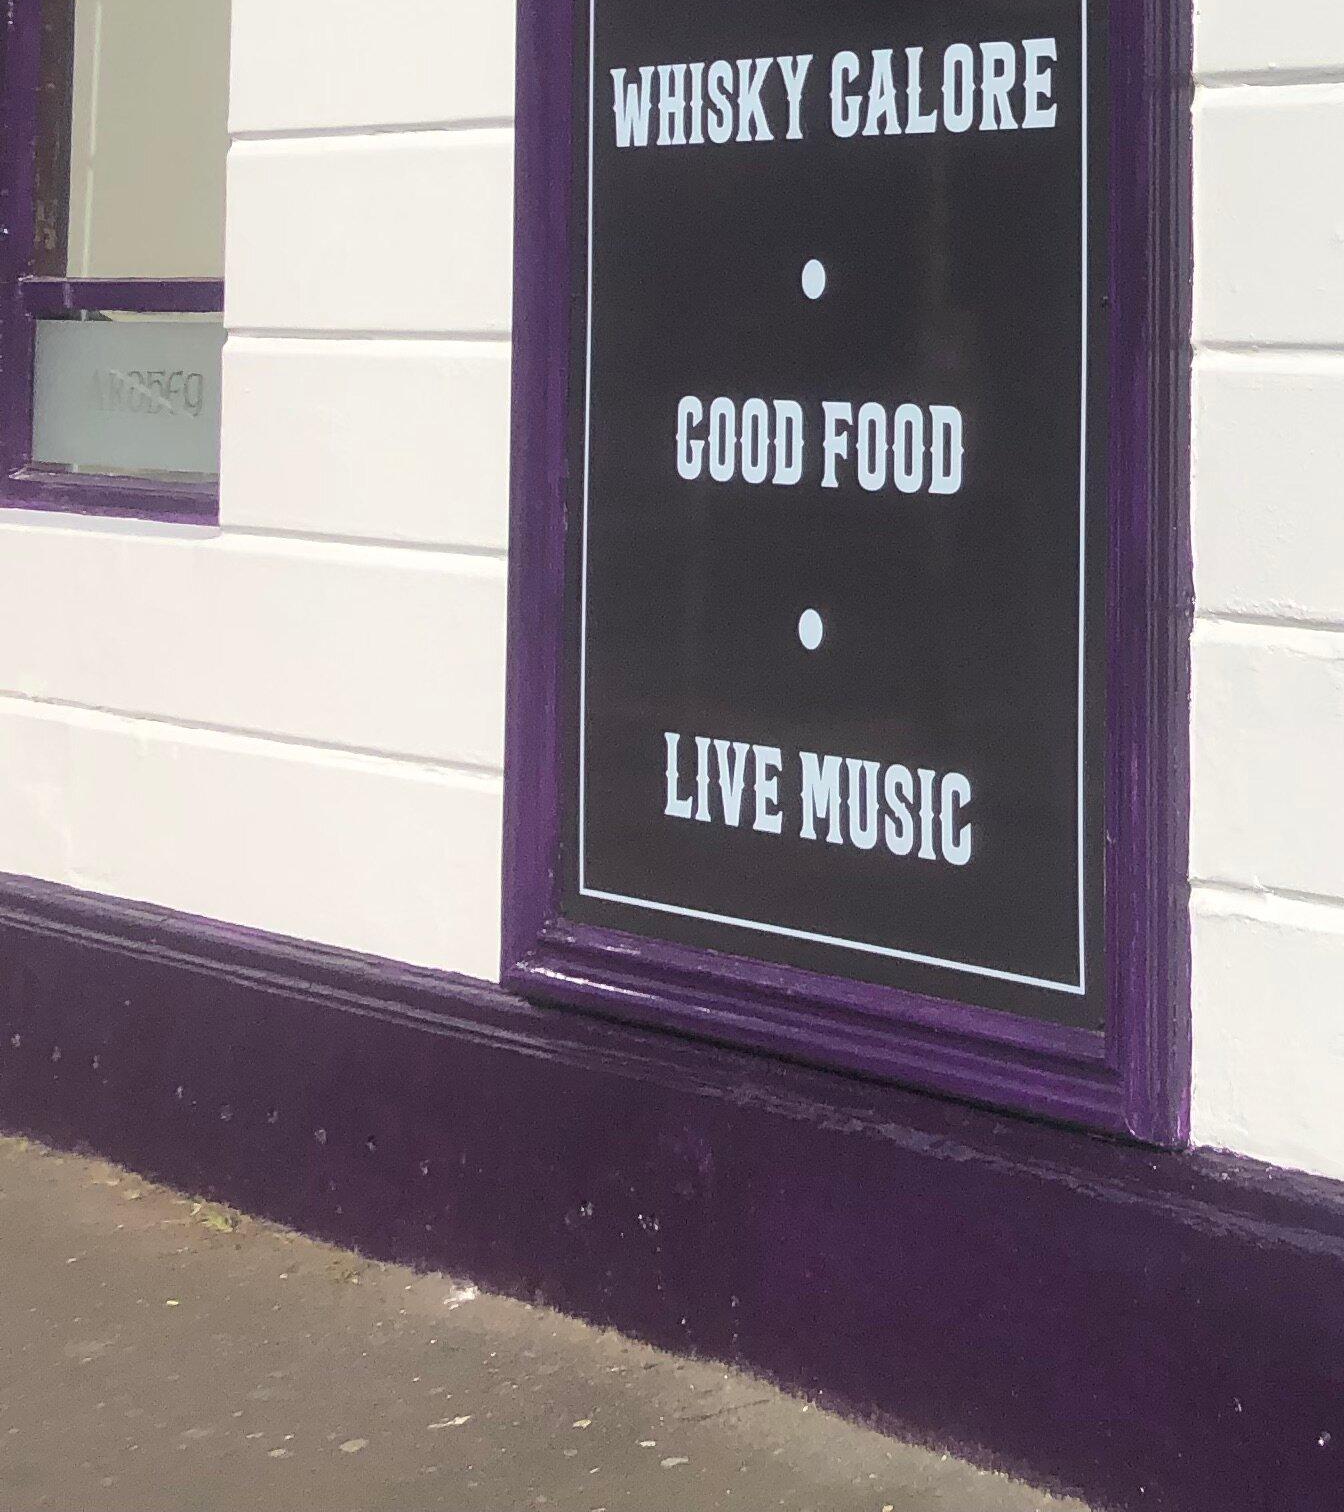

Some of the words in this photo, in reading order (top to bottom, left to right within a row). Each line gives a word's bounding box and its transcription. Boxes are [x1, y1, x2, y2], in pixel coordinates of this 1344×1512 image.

[610, 54, 813, 147] WHISKY
[829, 38, 1057, 137] GALORE
[676, 396, 804, 485] GOOD
[821, 401, 964, 494] FOOD
[664, 732, 783, 834] LIVE
[799, 751, 971, 865] MUSIC
